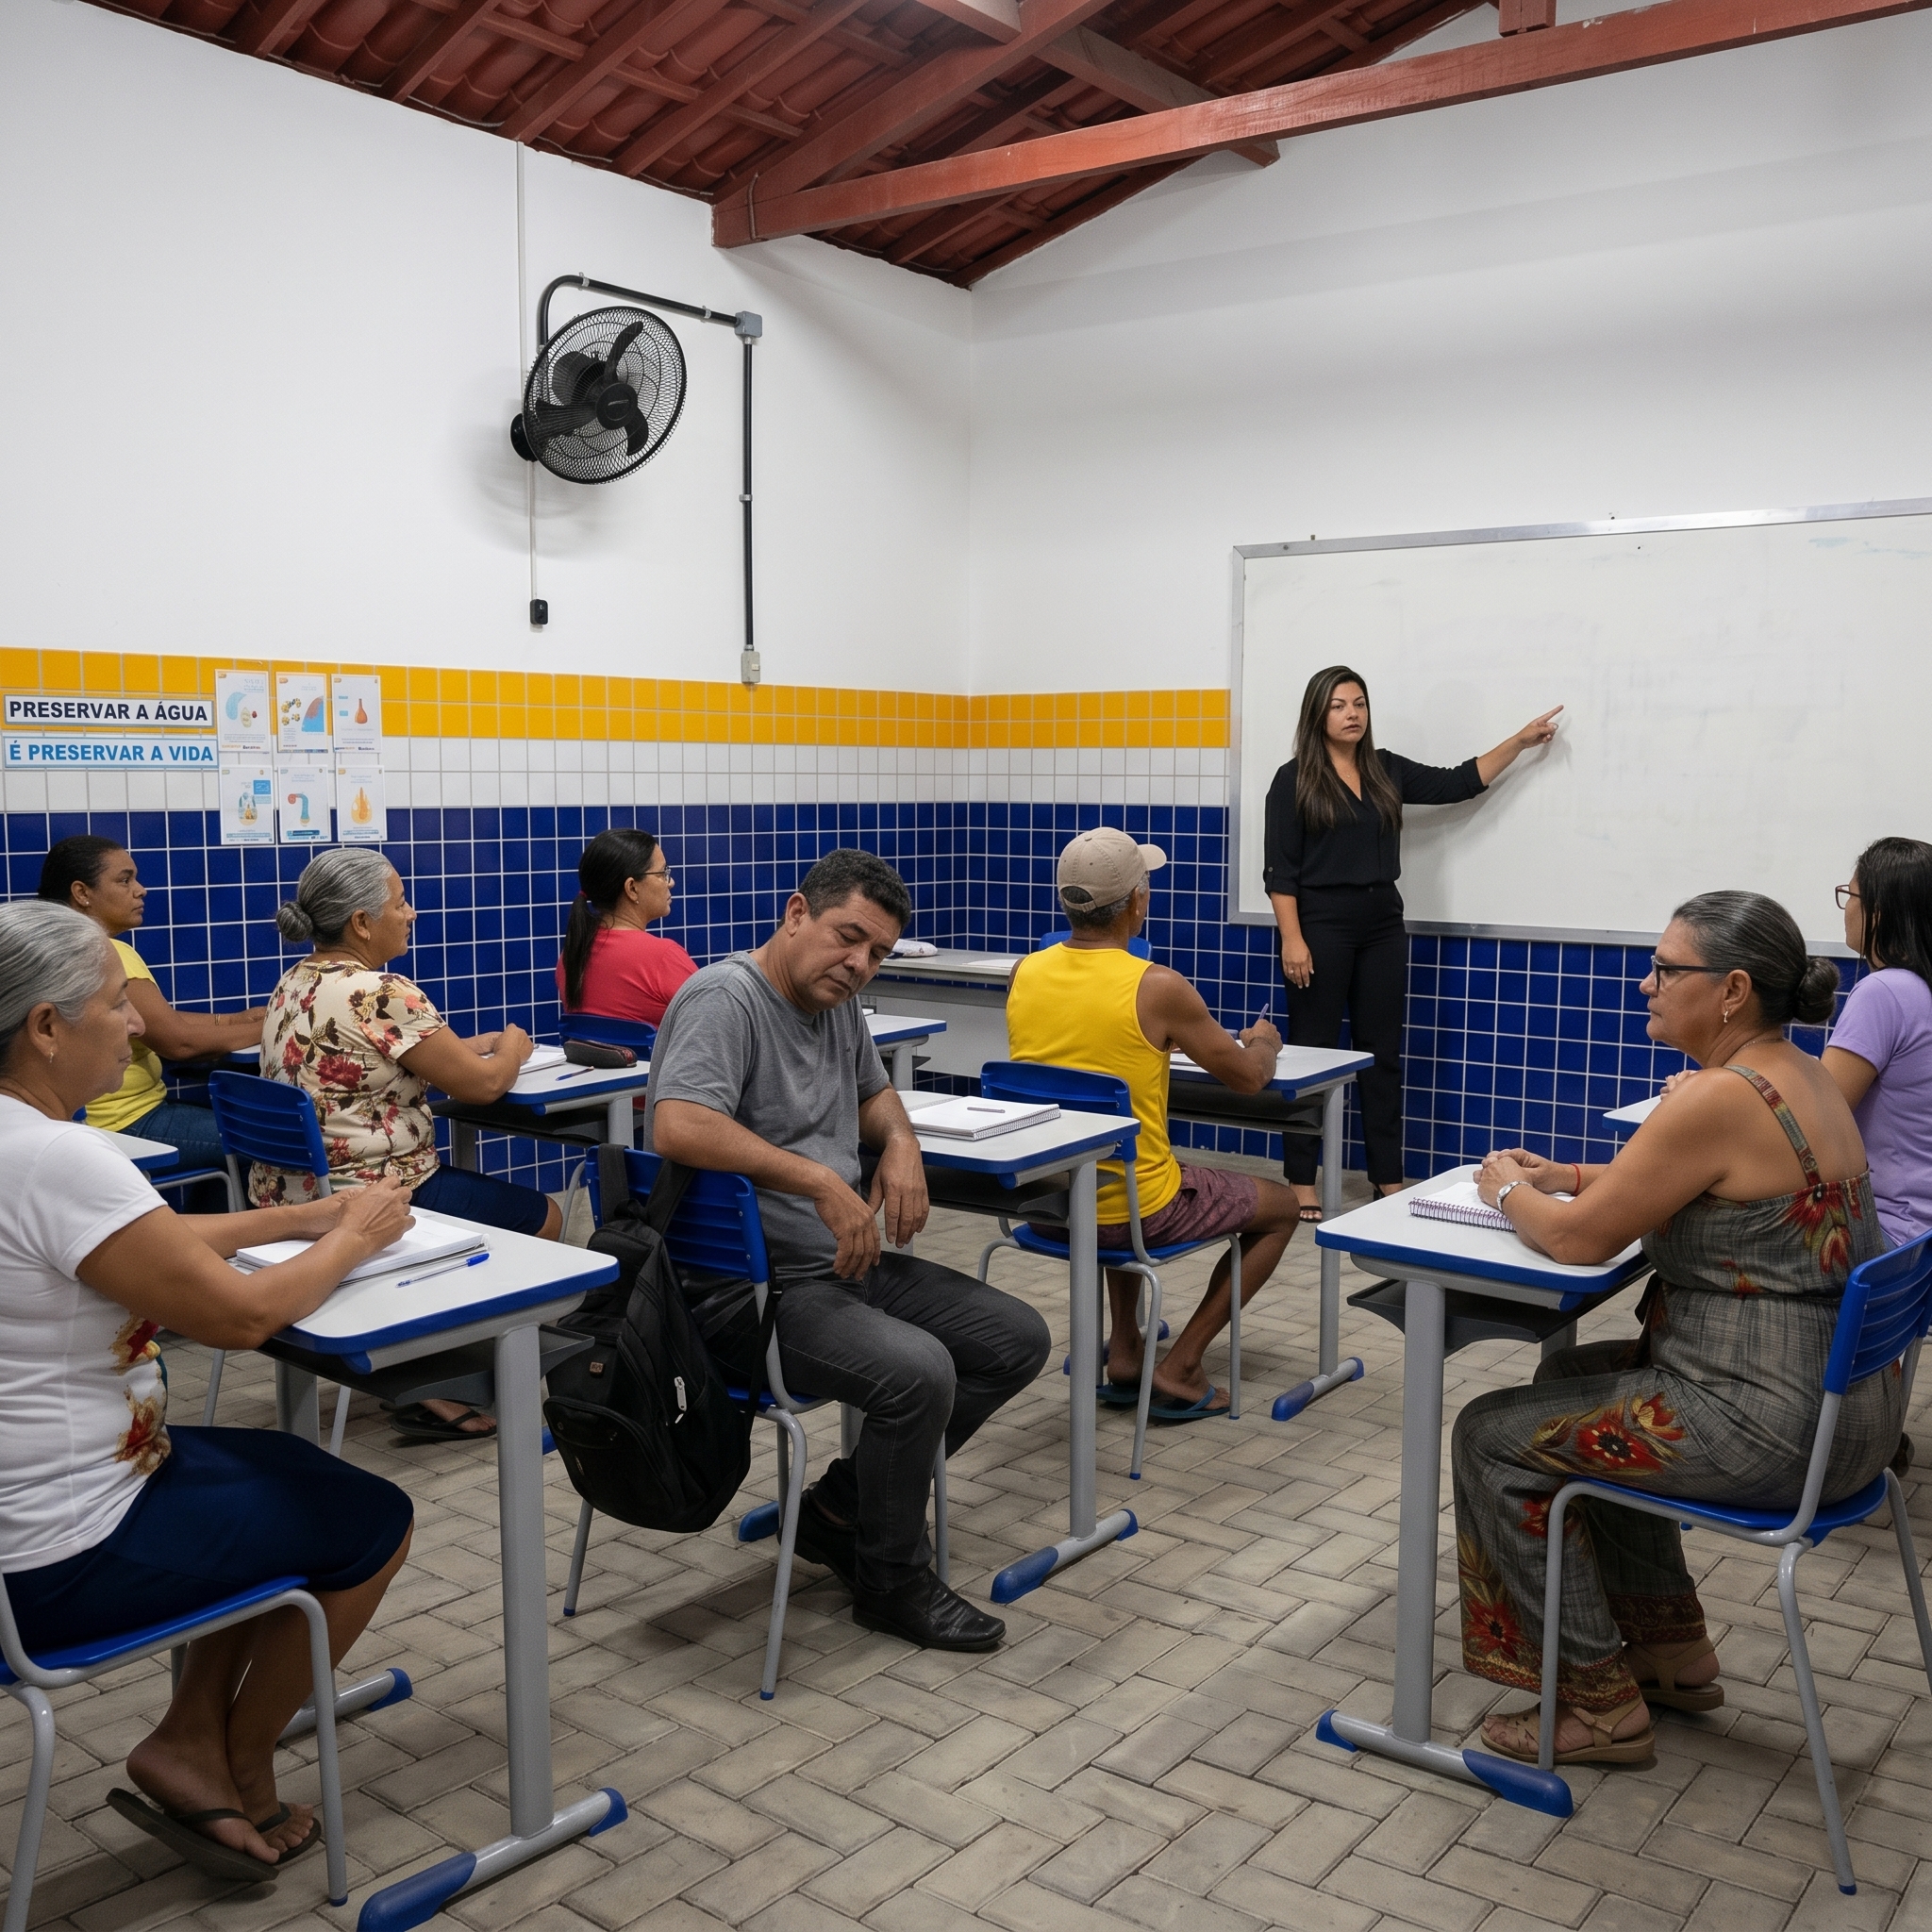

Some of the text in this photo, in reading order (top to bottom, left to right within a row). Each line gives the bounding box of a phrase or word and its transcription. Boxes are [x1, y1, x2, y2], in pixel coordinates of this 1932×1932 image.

[9, 701, 208, 721] PRESERVAR A ÁGUA
[9, 740, 213, 761] É PRESERVAR A VIDA
